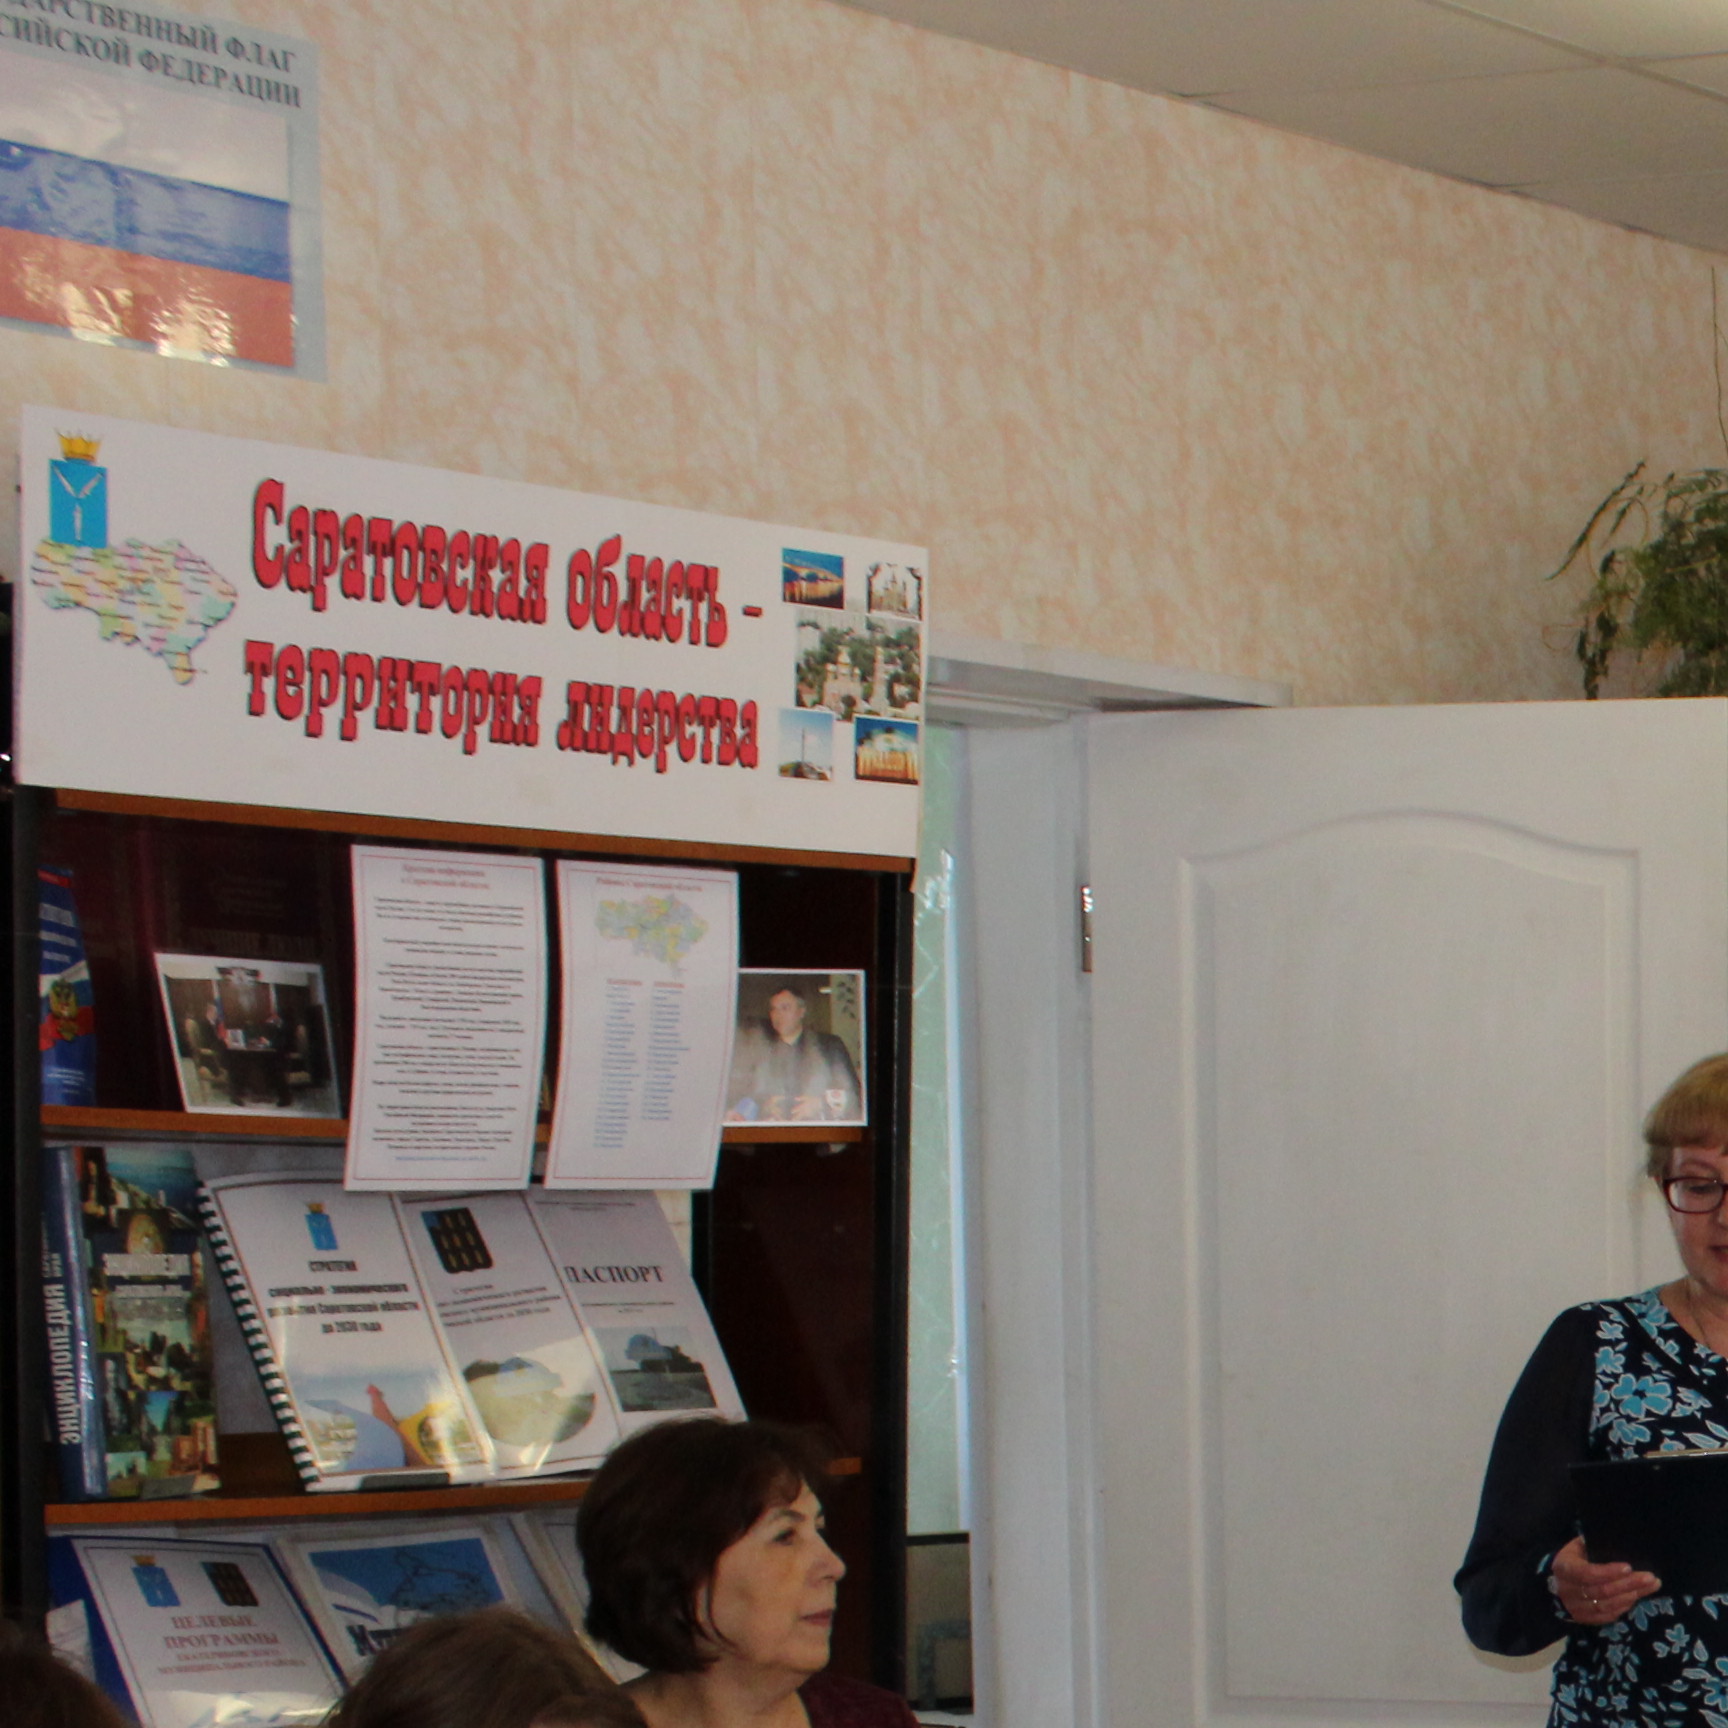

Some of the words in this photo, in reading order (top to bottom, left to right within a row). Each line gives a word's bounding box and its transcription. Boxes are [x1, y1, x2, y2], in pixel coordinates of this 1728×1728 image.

[138, 49, 302, 108] ФЕДЕРАЦИИ
[223, 36, 297, 73] ФЛАГ
[251, 477, 549, 625] Саратовская
[567, 535, 728, 649] область
[244, 639, 541, 755] территория
[557, 678, 760, 772] лидерства
[563, 1264, 664, 1283] ПАСПОРТ
[43, 1283, 82, 1446] ЭНЦИКЛОПЕДИЯ
[163, 1632, 280, 1649] ПРОГРАММЫ
[171, 1615, 257, 1630] ЦЕЛЕВЫЕ
